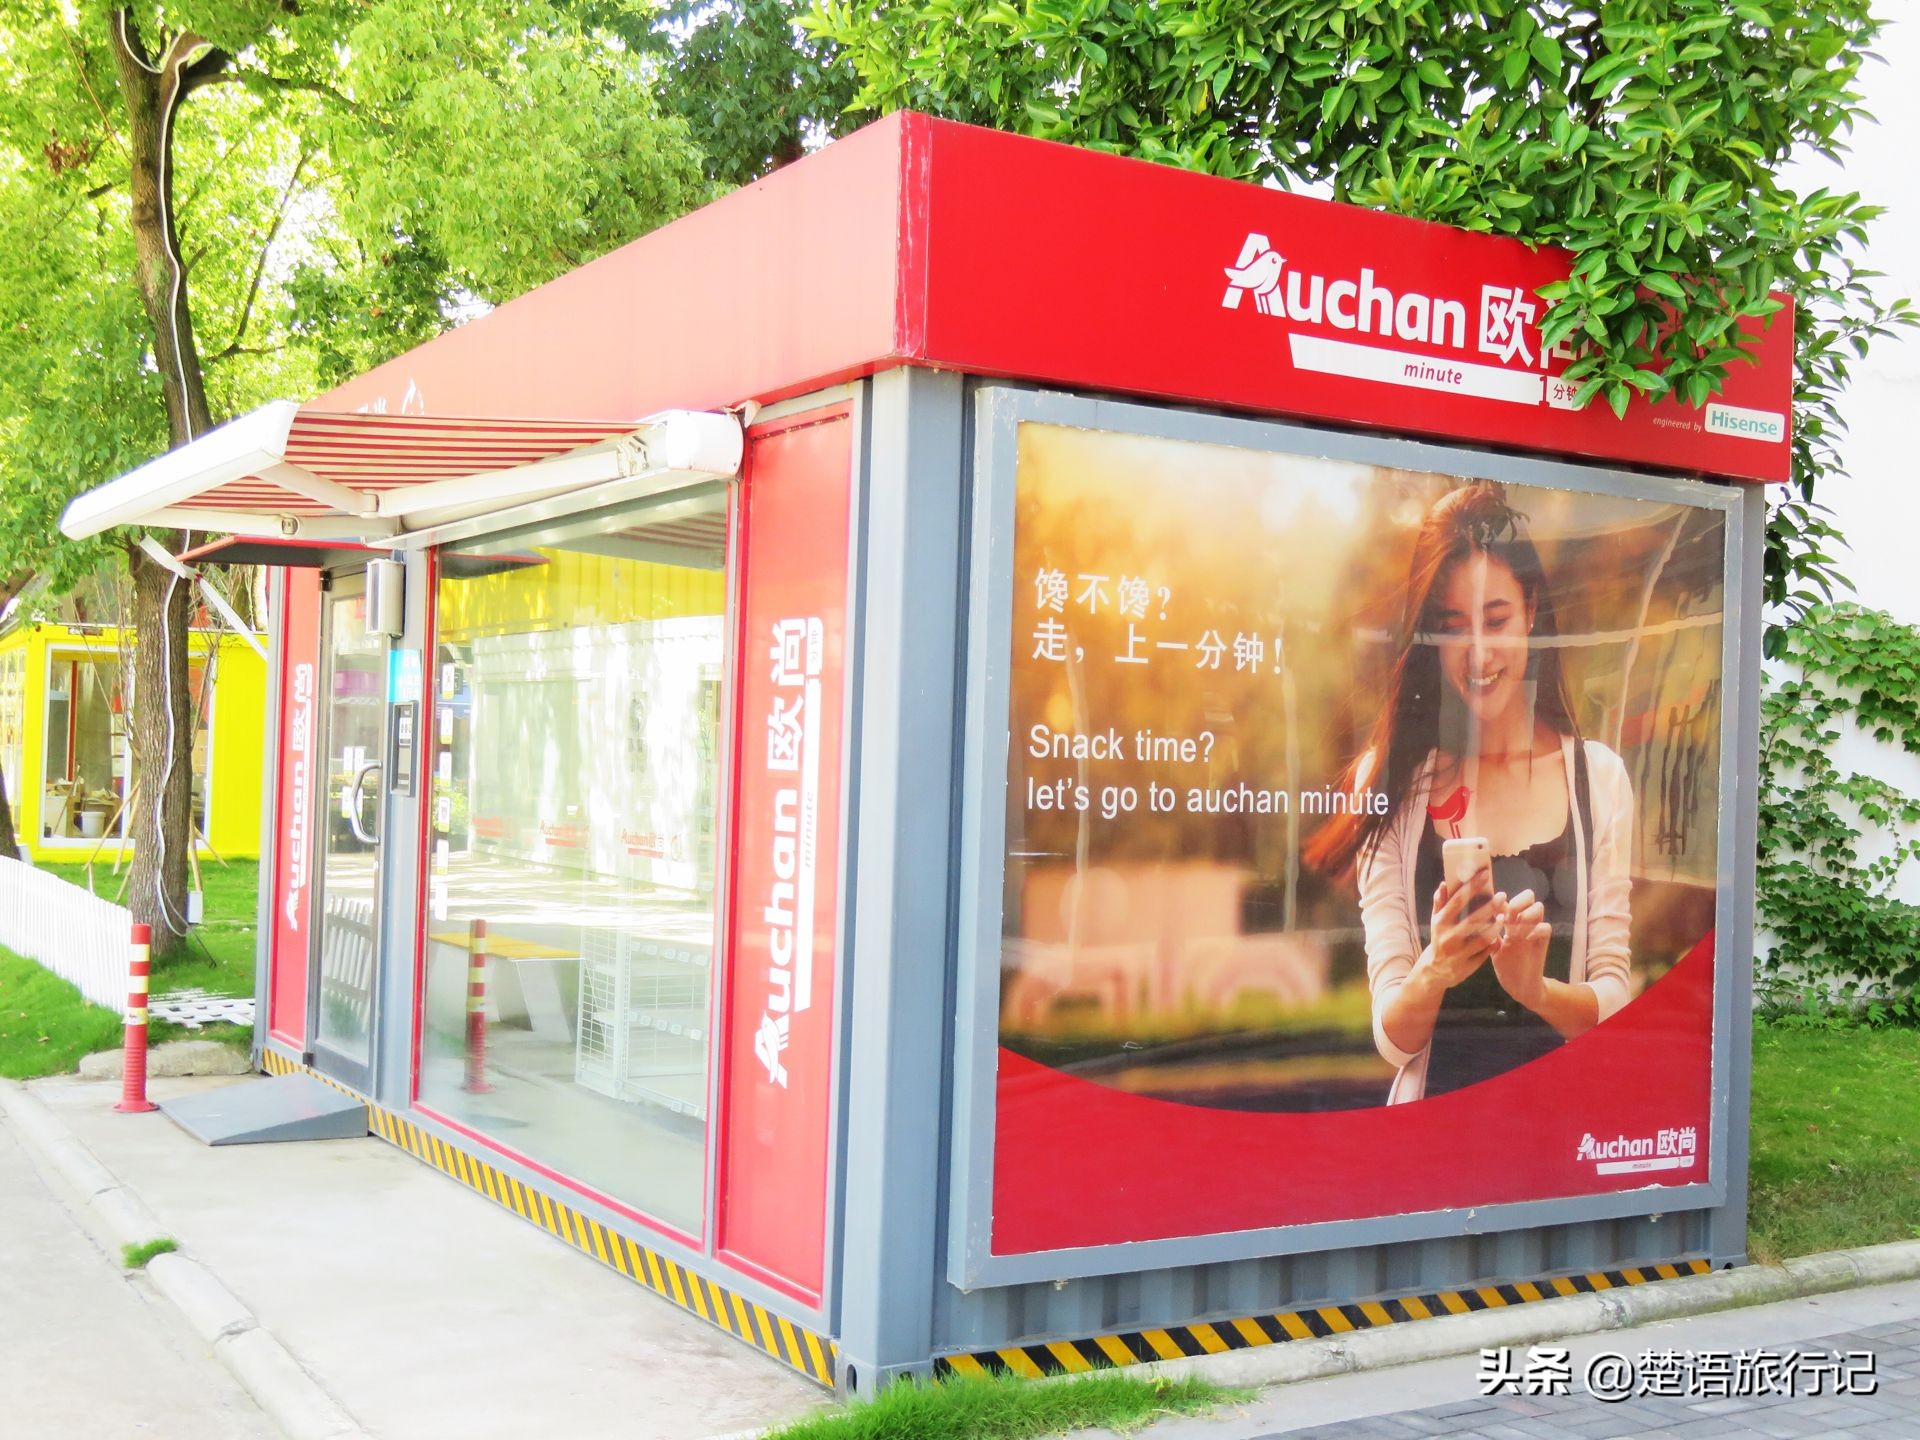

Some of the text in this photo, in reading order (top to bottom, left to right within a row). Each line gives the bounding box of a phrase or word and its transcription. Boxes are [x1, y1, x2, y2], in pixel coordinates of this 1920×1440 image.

[1222, 233, 1466, 349] Auchan
[1404, 362, 1463, 385] minute
[1652, 410, 1778, 435] engineered by Hisense
[1035, 567, 1171, 620] 馋不馋？
[1029, 724, 1215, 763] Snack time?
[1027, 777, 1389, 819] let’s go to auchan minute
[284, 761, 303, 931] Auchan
[755, 618, 806, 1088] Auchan 欧尚
[1577, 1126, 1697, 1160] Auchan 欧尚
